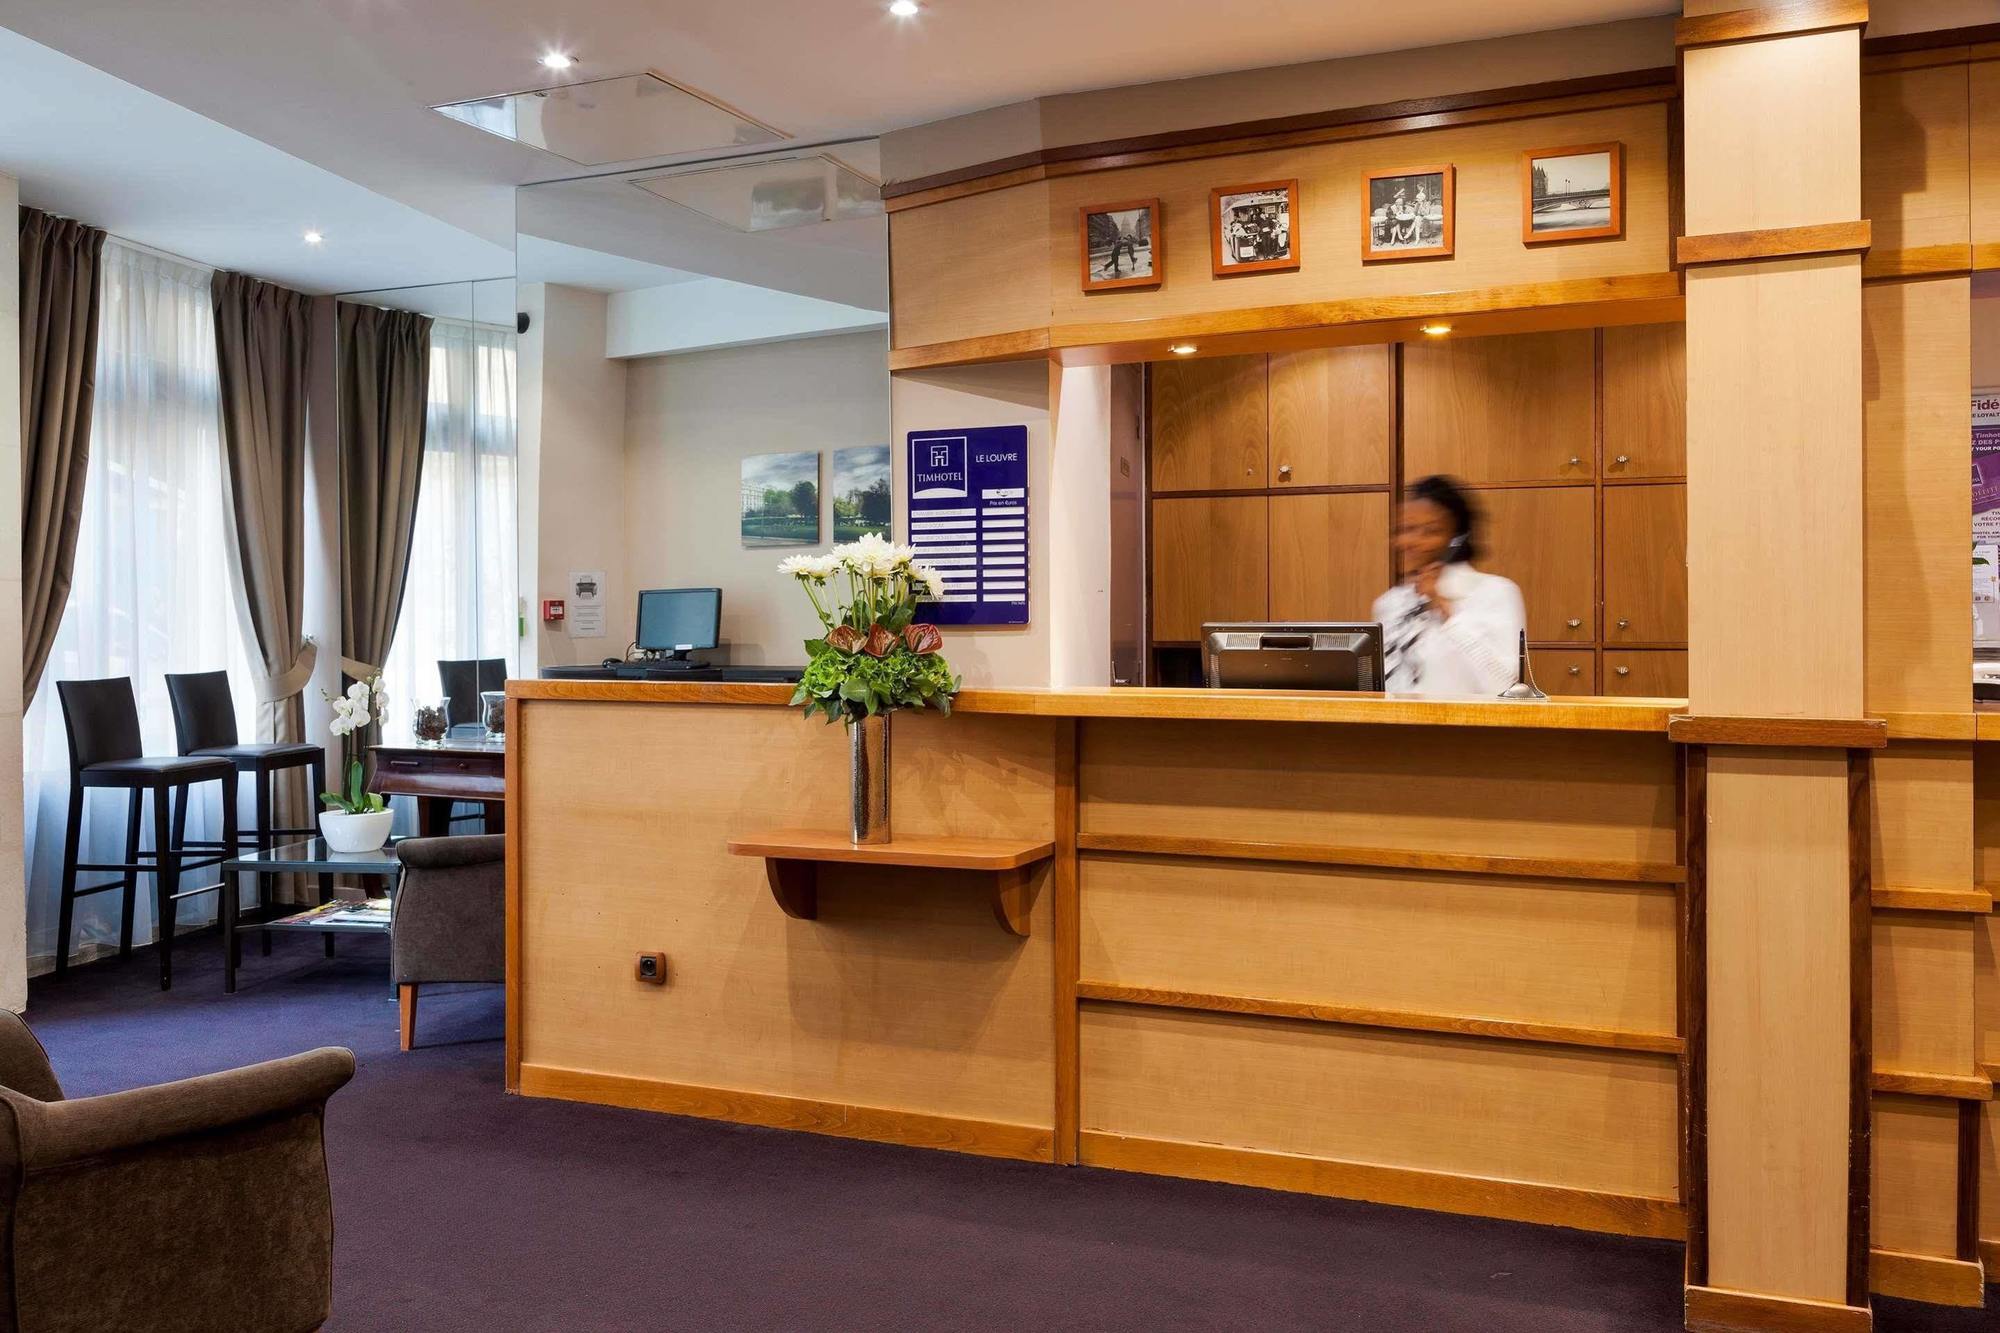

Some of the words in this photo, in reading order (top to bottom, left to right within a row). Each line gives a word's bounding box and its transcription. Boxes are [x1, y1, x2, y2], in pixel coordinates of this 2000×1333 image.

[975, 454, 985, 463] LE
[985, 453, 1018, 462] LOUVRE
[916, 472, 963, 483] TIMHOTEL
